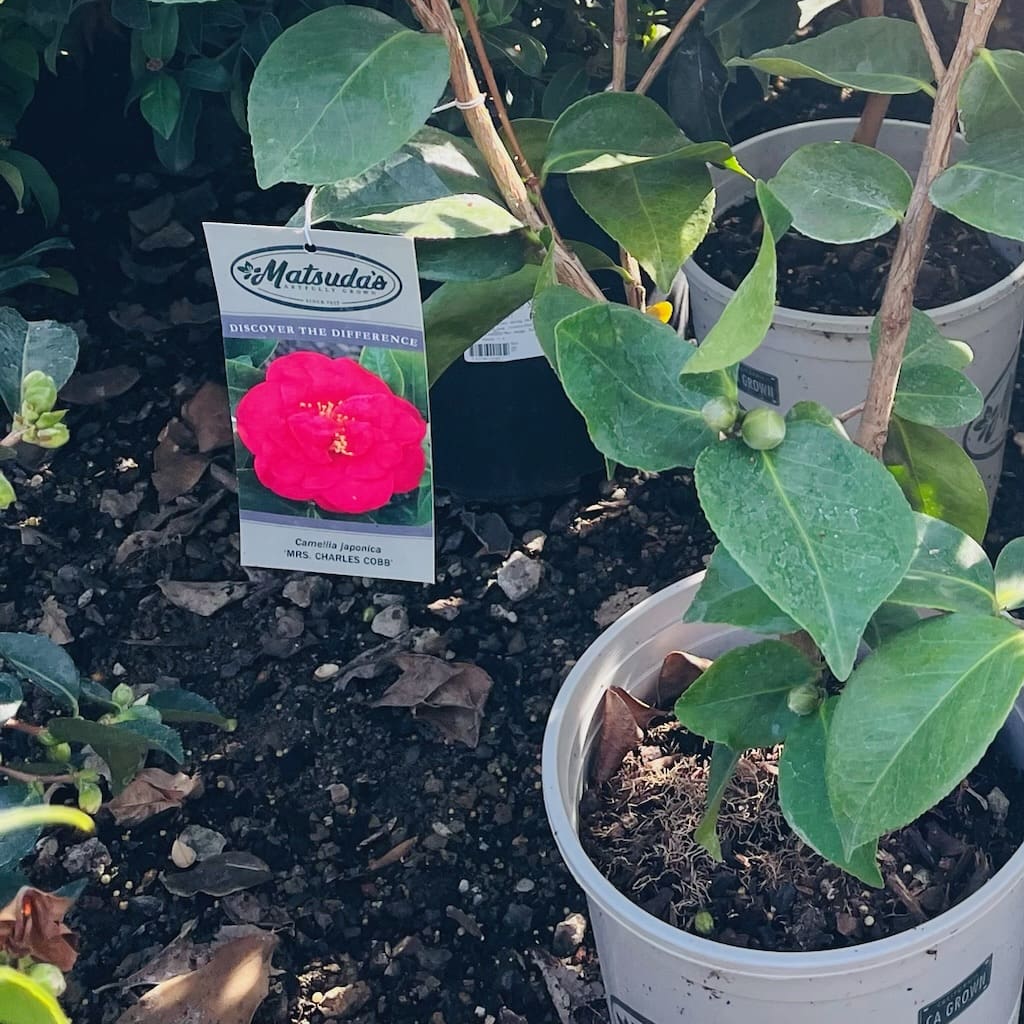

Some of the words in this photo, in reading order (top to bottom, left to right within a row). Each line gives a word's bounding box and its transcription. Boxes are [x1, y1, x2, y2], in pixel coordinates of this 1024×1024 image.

[251, 258, 388, 289] Matsuda's
[229, 323, 295, 334] DISCOVER
[299, 326, 328, 337] THE
[331, 328, 418, 348] DIFFERENCE
[295, 537, 337, 550] Camellia
[340, 541, 382, 554] japonica
[315, 552, 360, 564] CHARLES
[945, 971, 987, 1017] GROWN
